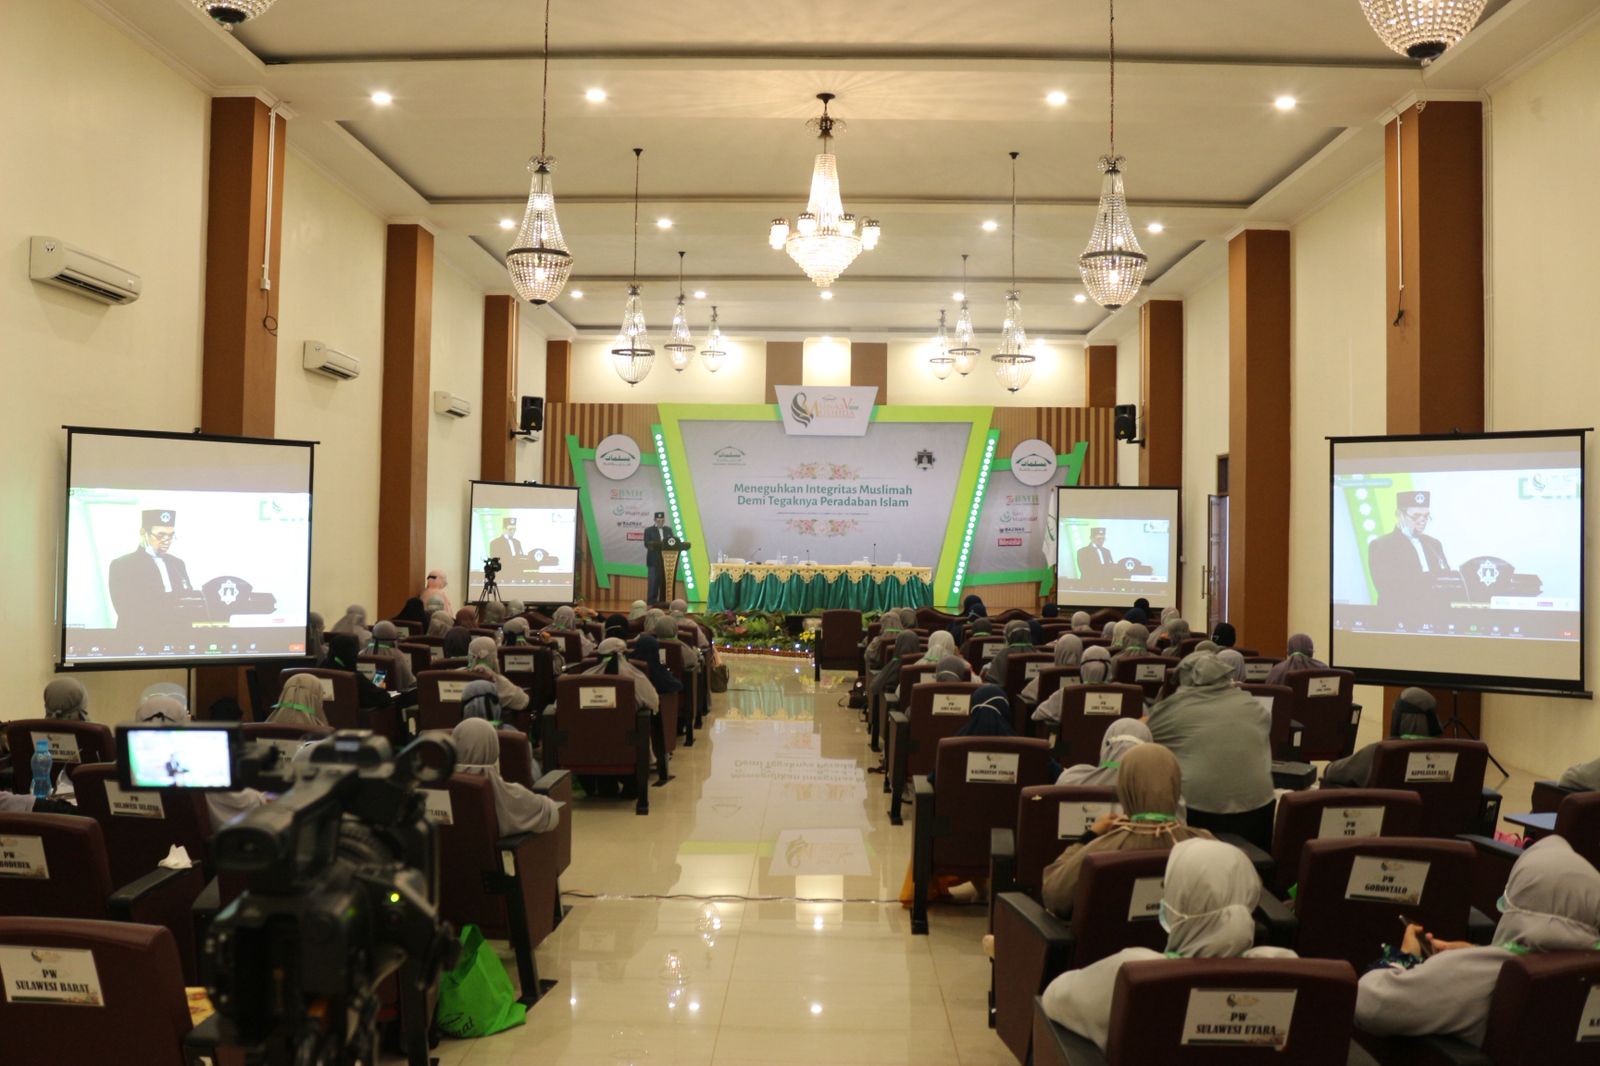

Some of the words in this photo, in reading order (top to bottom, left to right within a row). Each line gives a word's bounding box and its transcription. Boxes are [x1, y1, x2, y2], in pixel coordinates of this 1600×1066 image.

[734, 483, 803, 495] Meneguhkan
[806, 484, 857, 496] Integritas
[859, 485, 912, 495] Muslimah
[737, 495, 766, 505] Demi
[768, 496, 818, 507] Tegaknya
[820, 496, 877, 507] Peradaban
[880, 497, 909, 507] Islam
[1382, 875, 1395, 884] PW
[1364, 883, 1408, 895] GORONTALO
[42, 968, 57, 979] PW
[15, 979, 58, 992] SULAWESI
[59, 982, 89, 993] BARAT
[1230, 1011, 1248, 1022] PW
[1195, 1024, 1242, 1035] SULAWESI
[1244, 1025, 1277, 1036] UTARA
